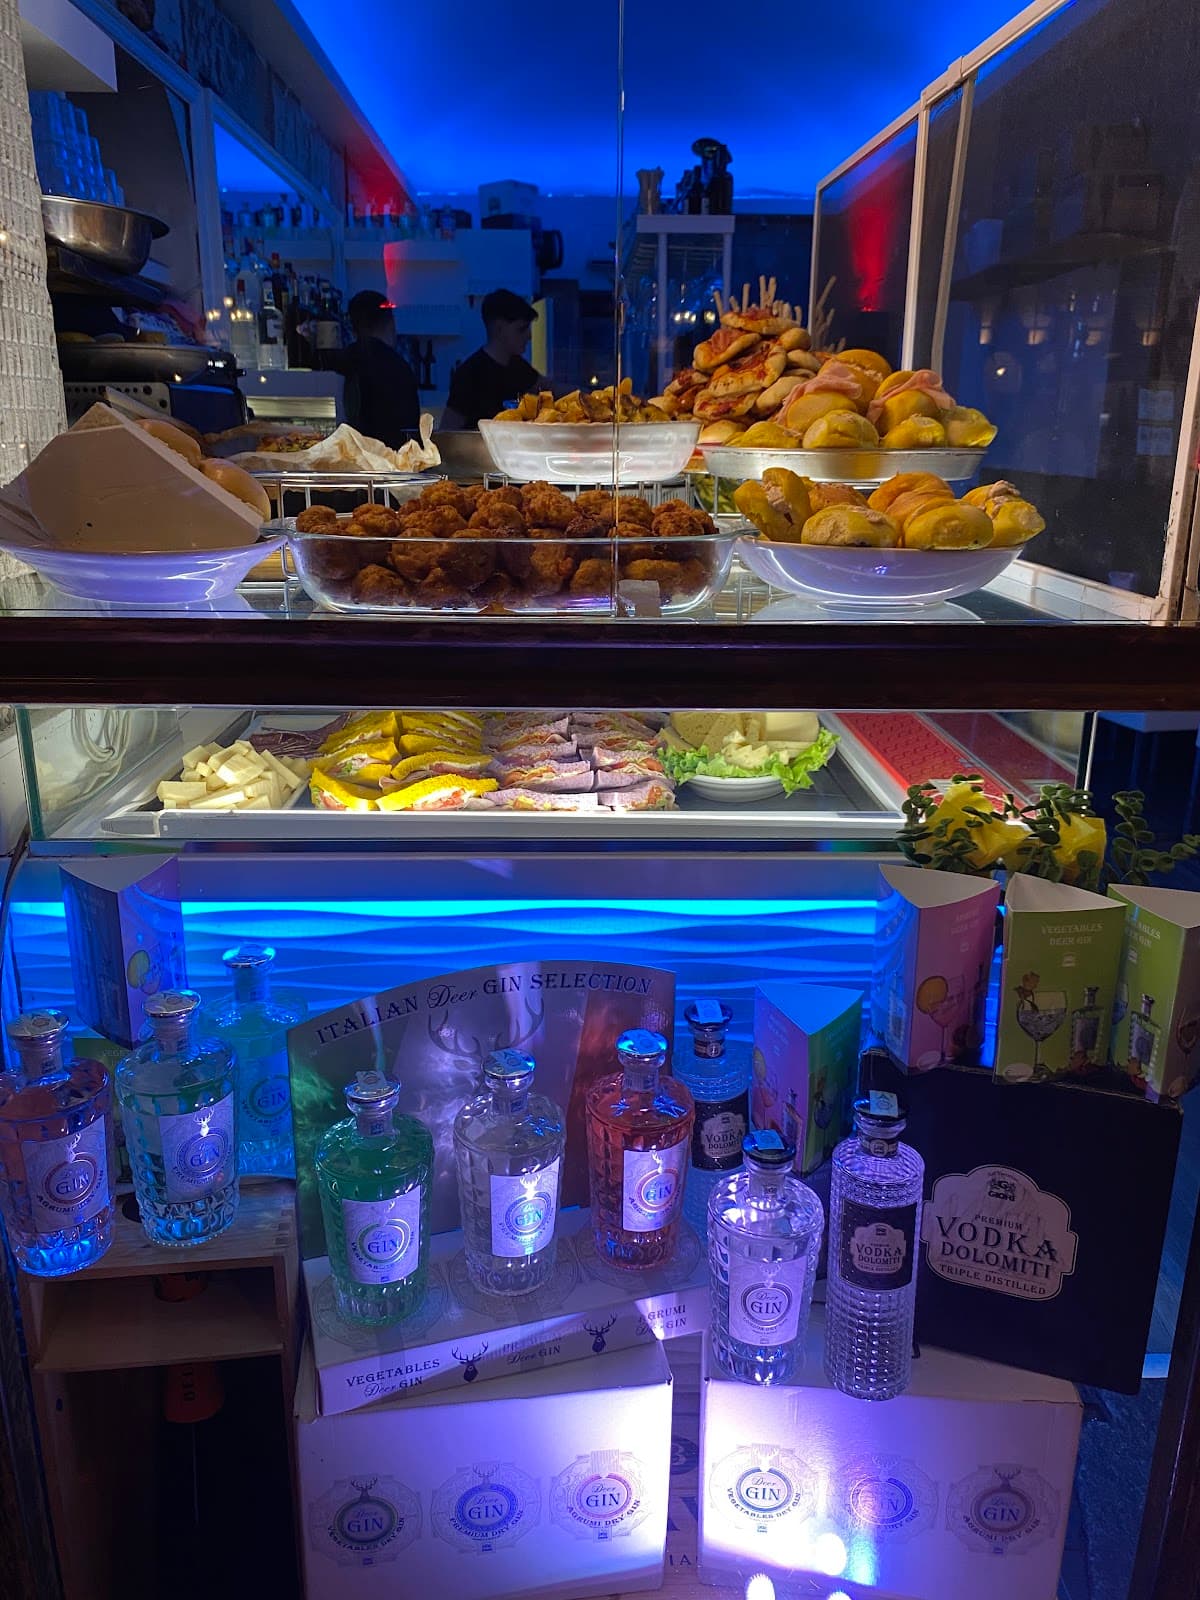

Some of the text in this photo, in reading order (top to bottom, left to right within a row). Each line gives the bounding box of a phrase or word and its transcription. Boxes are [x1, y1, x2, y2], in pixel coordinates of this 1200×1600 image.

[1041, 922, 1104, 935] VEGETABLES
[1049, 937, 1074, 945] DEER
[315, 973, 653, 1044] ITALIAN Deer GIN SELECTION
[256, 1090, 287, 1108] GIN
[705, 1129, 743, 1144] VODKA
[708, 1141, 740, 1150] DOLOM
[55, 1172, 90, 1195] GIN
[645, 1184, 672, 1202] GIN
[36, 1194, 75, 1213] AGRUMI
[515, 1208, 543, 1226] GIN
[974, 1214, 1023, 1231] PREMIUM
[367, 1239, 399, 1254] GIN
[935, 1215, 1059, 1263] VODKA
[855, 1243, 902, 1257] VODKA
[858, 1254, 900, 1265] DOLOMITI
[941, 1241, 1052, 1279] DOLOMITI
[940, 1264, 1046, 1295] TRIPLE DISTILLED
[754, 1291, 779, 1301] Deer
[750, 1301, 783, 1314] GIN
[665, 1317, 688, 1329] GIN
[506, 1344, 561, 1365] Deer GIN
[345, 1359, 440, 1387] VEGETABLES
[364, 1376, 423, 1397] Deer GIN
[592, 1483, 617, 1493] Deer
[751, 1477, 777, 1486] Deer
[476, 1495, 499, 1506] Deer
[585, 1493, 620, 1508] GIN
[745, 1487, 782, 1501] GIN
[727, 1488, 774, 1519] VEGETABLES
[776, 1507, 792, 1518] DRY
[468, 1504, 504, 1520] GIN
[567, 1499, 641, 1527] AGRUMI DRY GIN
[983, 1507, 1020, 1521] GIN
[347, 1517, 384, 1533] GIN
[450, 1518, 489, 1538] PREMIUM
[491, 1525, 510, 1537] DRY
[962, 1514, 998, 1541] AGRUMI
